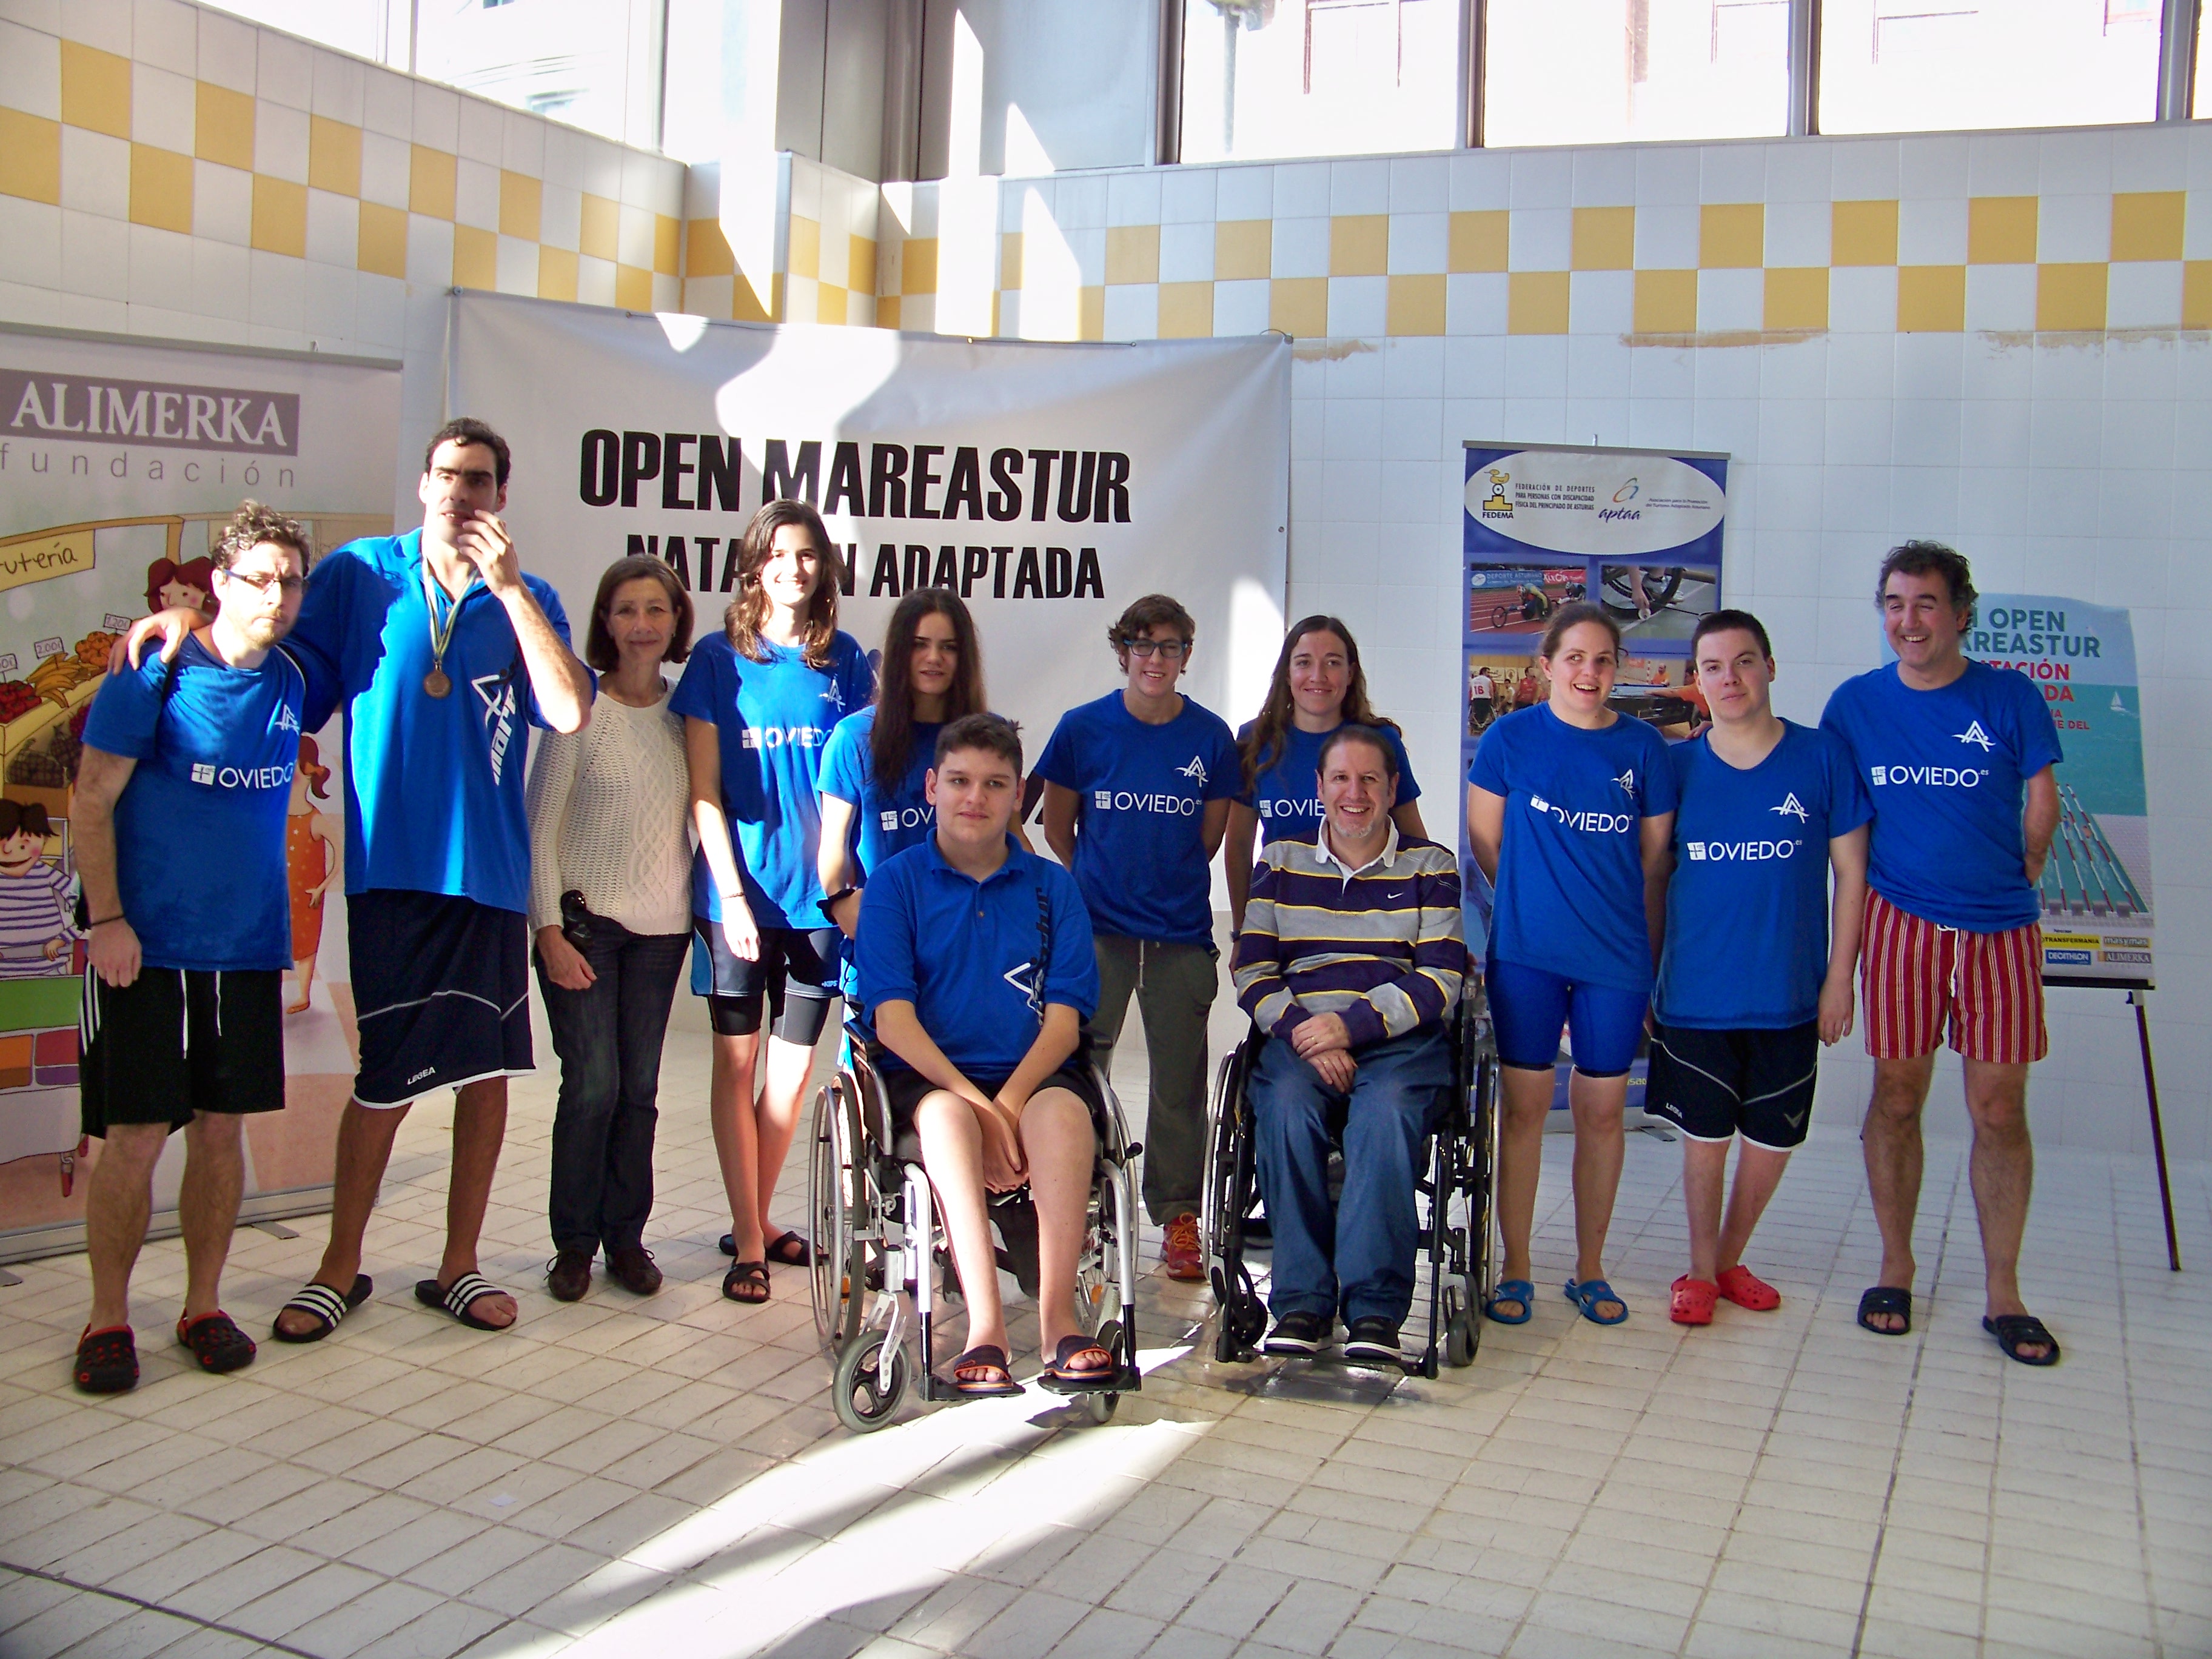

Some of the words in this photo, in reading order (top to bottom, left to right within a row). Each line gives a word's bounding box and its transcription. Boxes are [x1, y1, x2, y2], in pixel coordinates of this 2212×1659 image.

[11, 381, 287, 446] ALIMERKA
[0, 443, 294, 488] fundación
[580, 429, 741, 512] OPEN
[762, 439, 1132, 523] MAREASTUR
[1515, 483, 1550, 491] FEDERACIÓN
[1598, 507, 1641, 523] aptaa
[0, 542, 78, 574] utería
[870, 544, 1104, 598] ADAPTADA
[1989, 608, 2065, 632] OPEN
[2068, 720, 2090, 730] DEL
[1275, 799, 1325, 817] OVIE
[2048, 952, 2089, 960] DECATHLON
[2106, 952, 2150, 963] ALIMERKA
